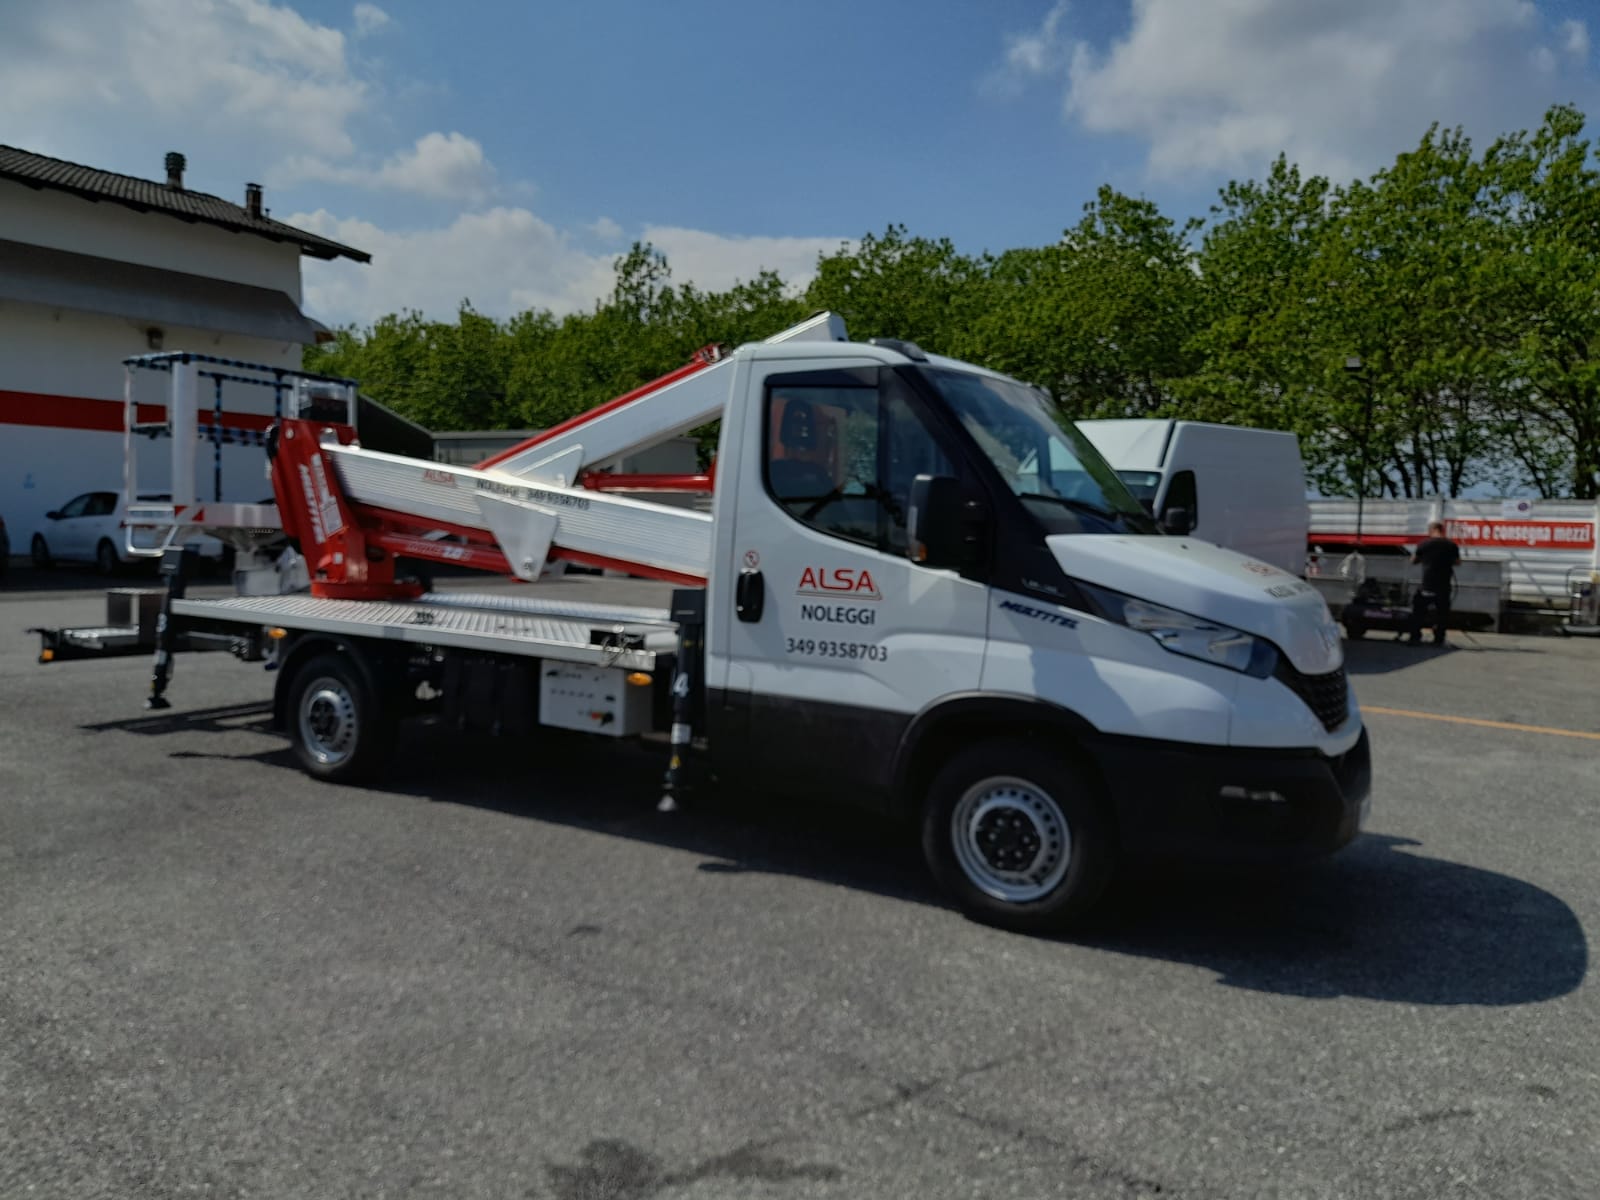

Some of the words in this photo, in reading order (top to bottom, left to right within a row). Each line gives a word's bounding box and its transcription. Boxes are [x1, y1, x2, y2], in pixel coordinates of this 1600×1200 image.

[1482, 524, 1491, 539] e
[1493, 525, 1551, 545] consegna
[1553, 525, 1590, 542] mezzi
[799, 567, 874, 593] ALSA
[801, 604, 875, 625] NOLEGGI
[786, 638, 815, 656] 349
[819, 640, 888, 662] 9358703
[673, 672, 689, 698] 4
